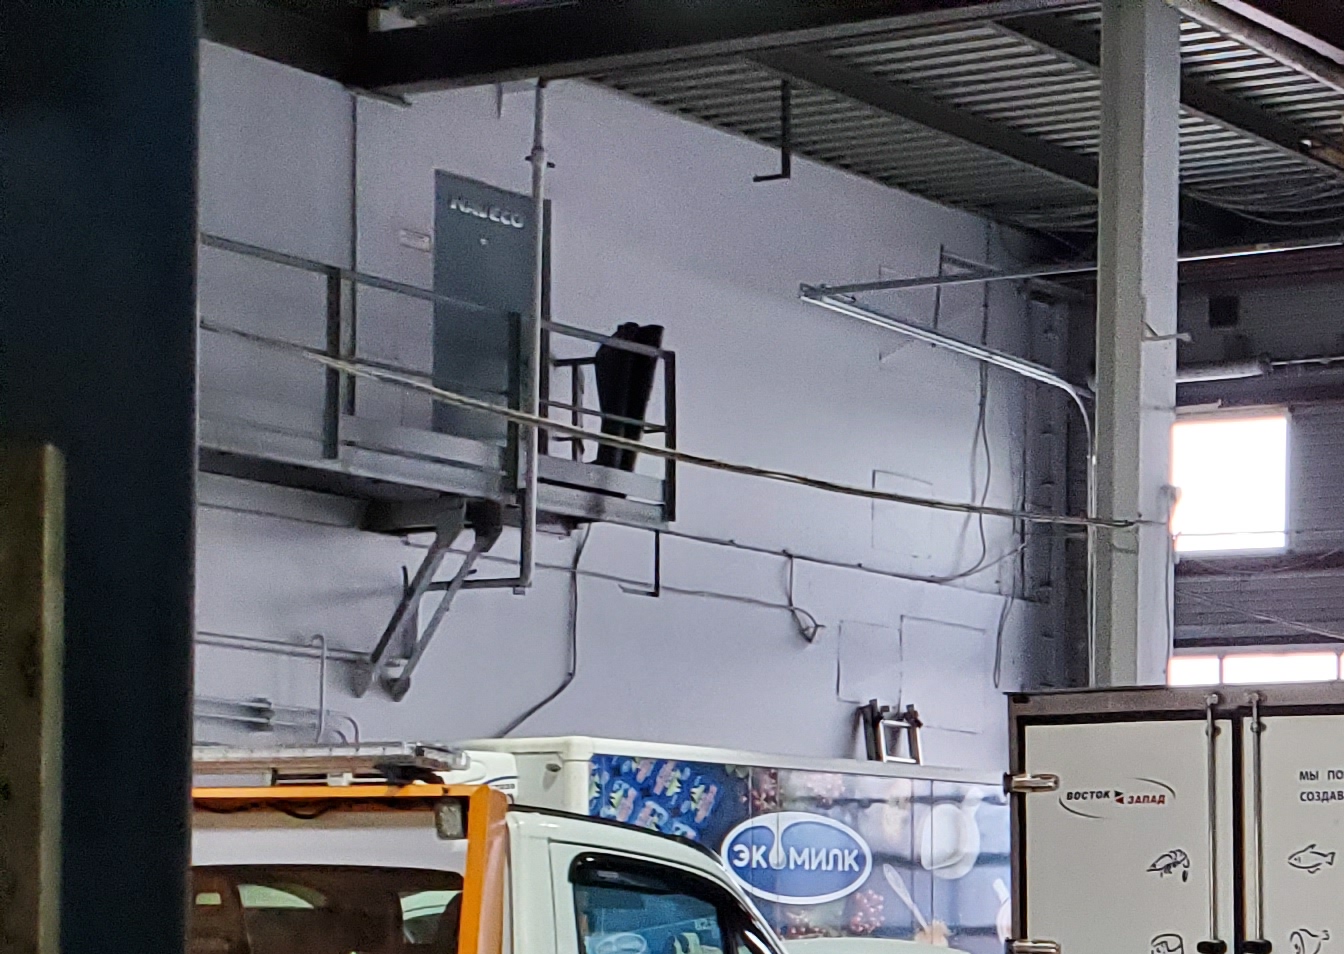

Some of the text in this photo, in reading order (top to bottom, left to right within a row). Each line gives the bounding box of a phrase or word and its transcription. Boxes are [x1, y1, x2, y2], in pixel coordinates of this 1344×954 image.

[1299, 770, 1319, 781] МЫ
[1066, 790, 1166, 805] ВОСТОК ЗАПАД
